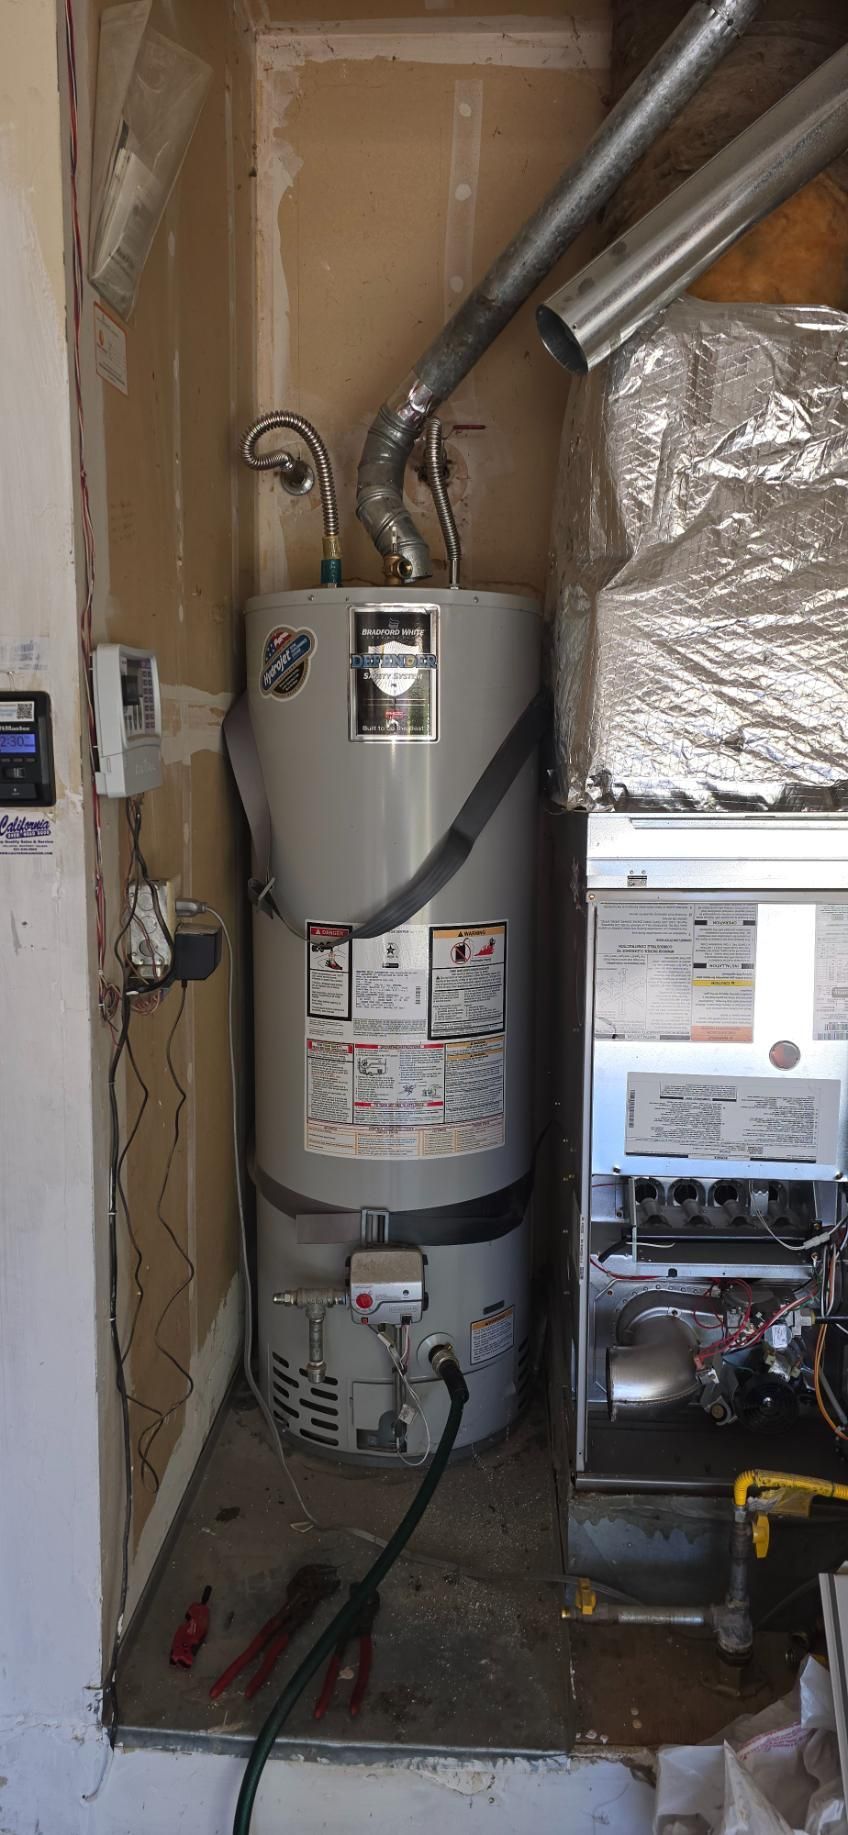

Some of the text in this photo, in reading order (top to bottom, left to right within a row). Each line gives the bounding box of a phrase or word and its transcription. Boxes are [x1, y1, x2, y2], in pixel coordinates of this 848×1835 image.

[361, 628, 425, 637] BRADFORD WHITE
[263, 649, 291, 686] Hydrojet
[351, 653, 438, 669] DEFENDER
[0, 814, 49, 836] California
